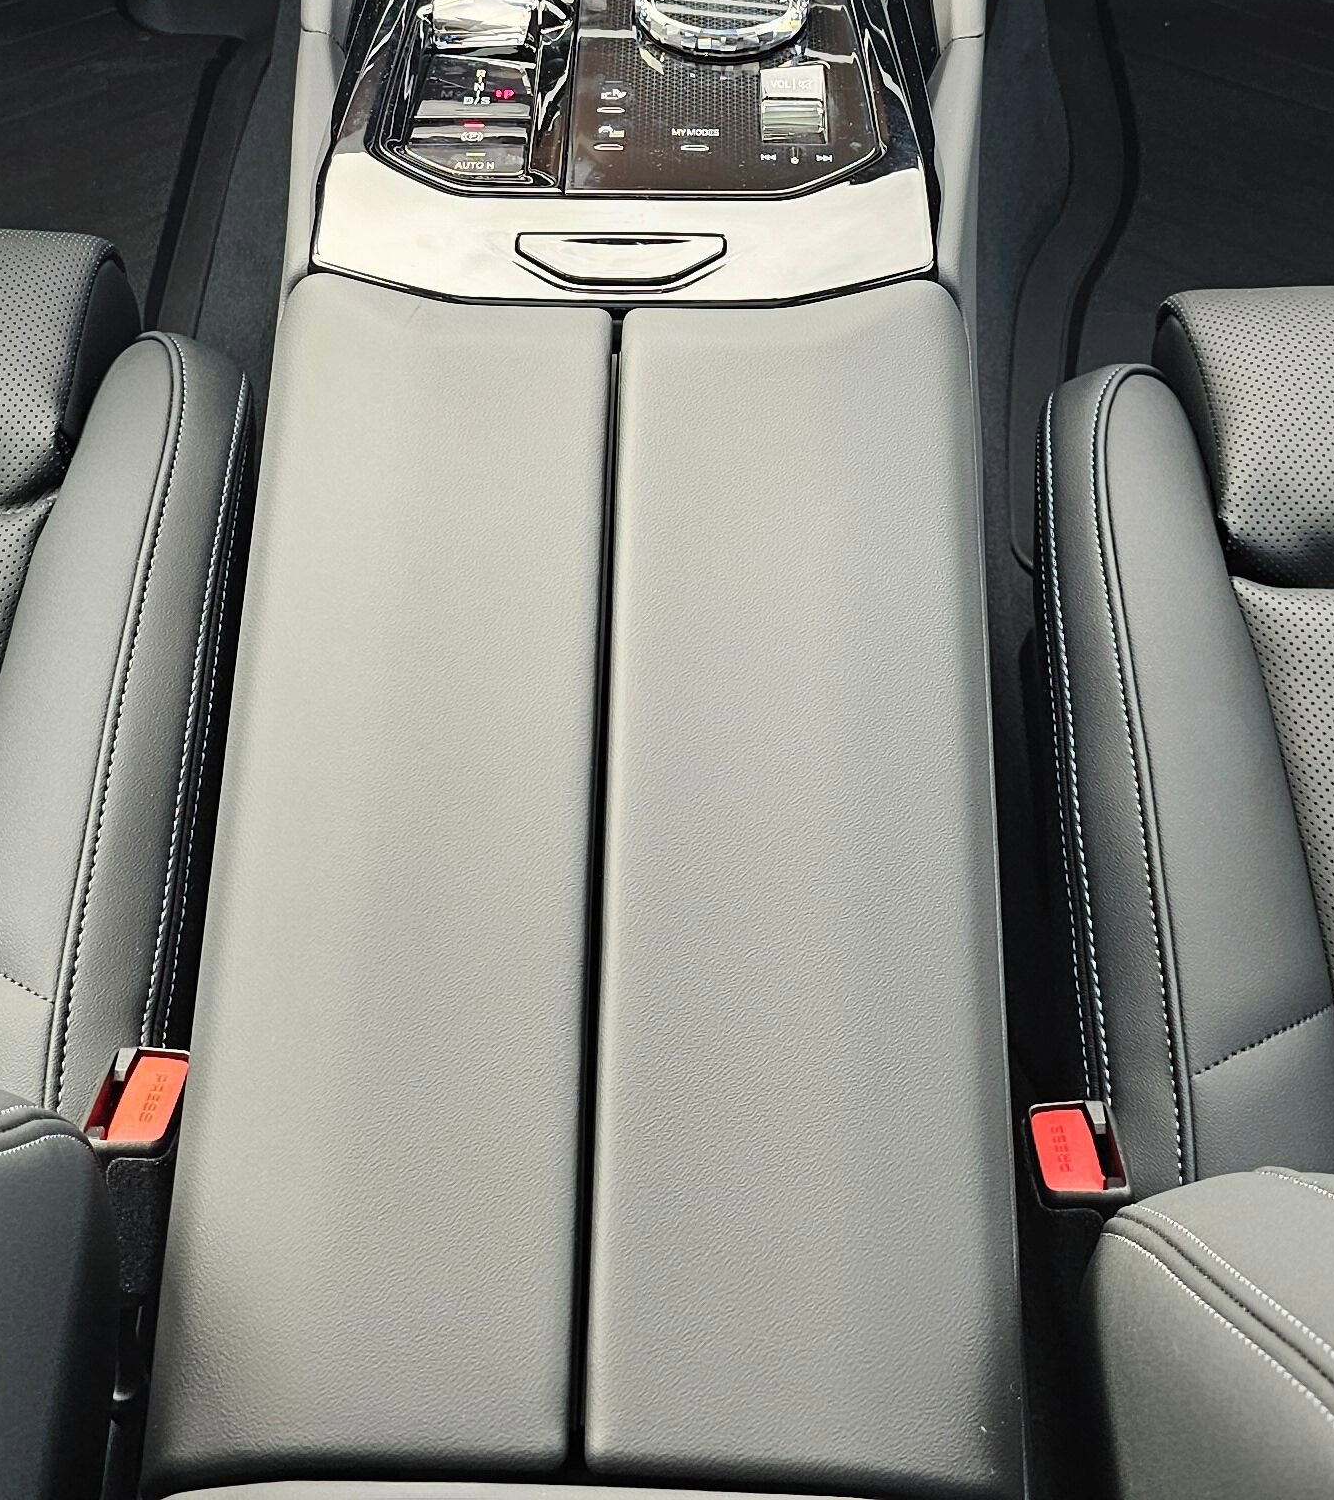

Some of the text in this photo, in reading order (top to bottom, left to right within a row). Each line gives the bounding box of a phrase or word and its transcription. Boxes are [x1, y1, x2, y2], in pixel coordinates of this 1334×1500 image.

[770, 78, 791, 89] VOL
[671, 128, 686, 137] MY
[454, 161, 485, 170] AUTO
[139, 1073, 168, 1123] PRESS
[1050, 1125, 1073, 1173] PRESS
